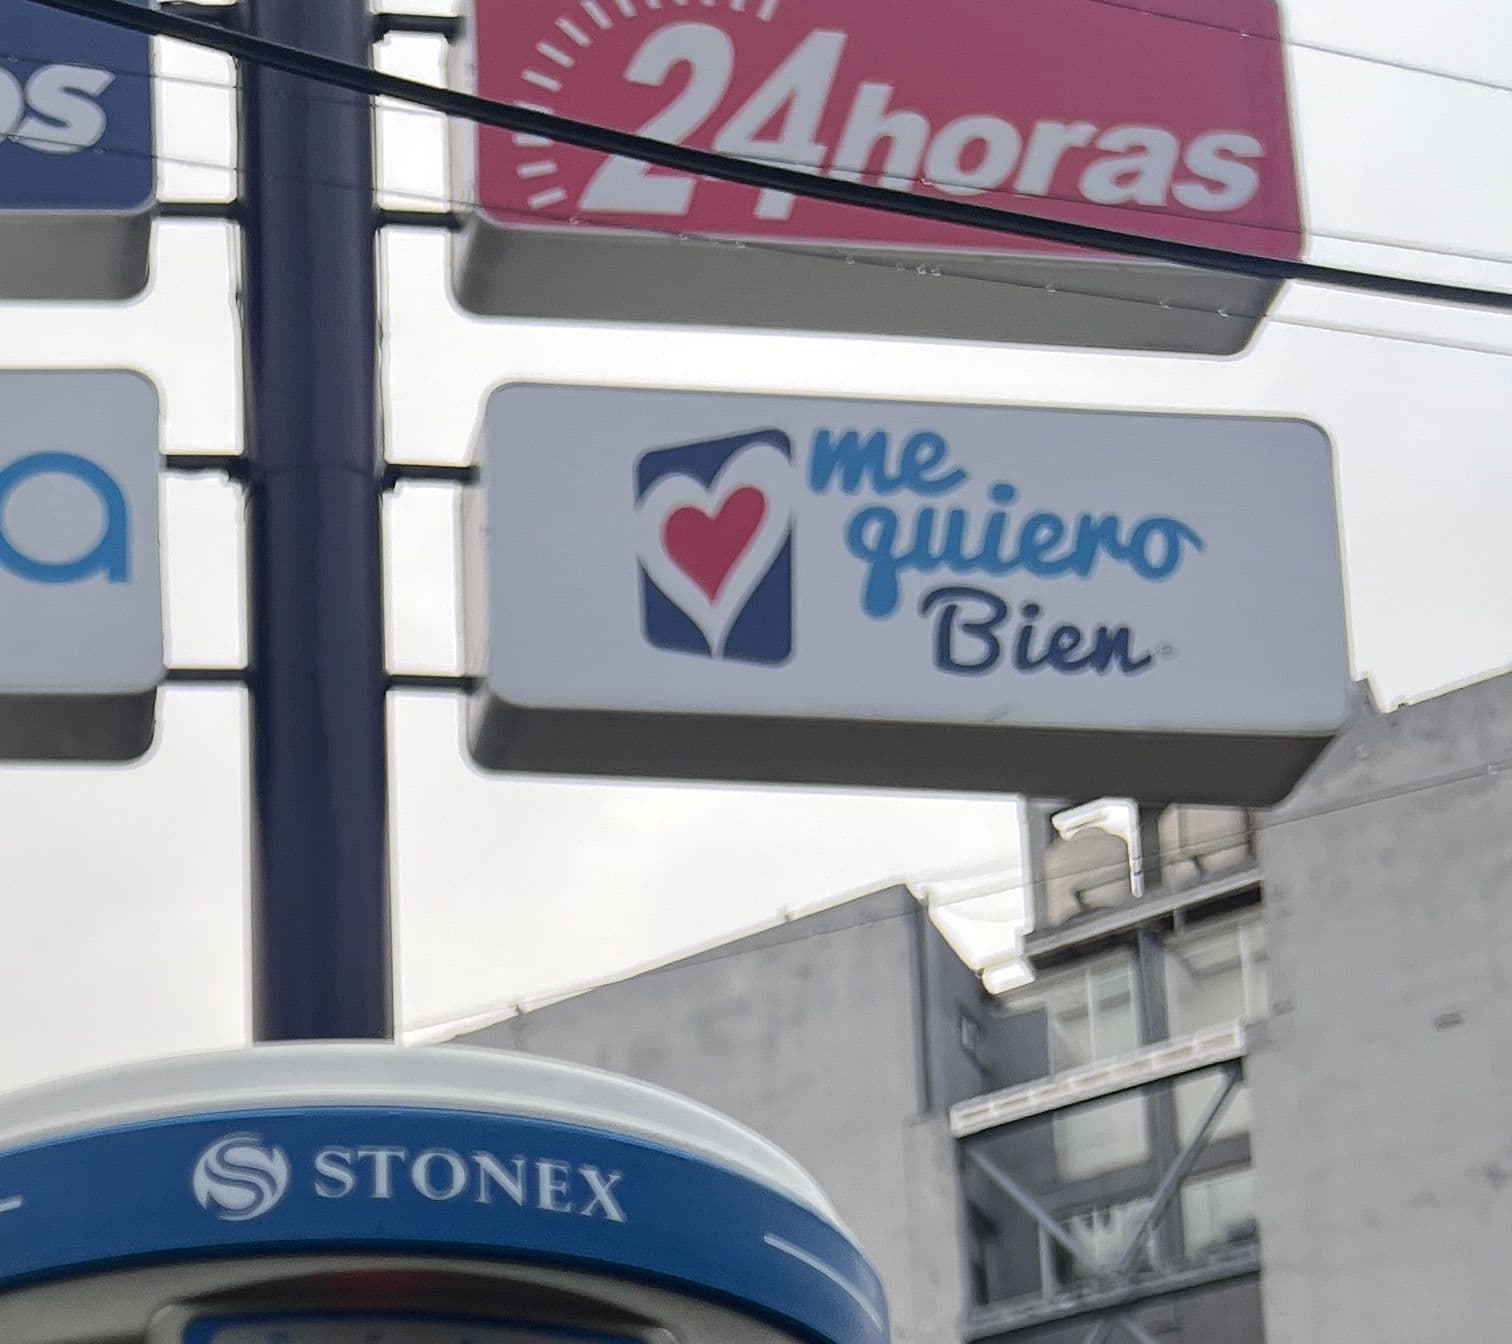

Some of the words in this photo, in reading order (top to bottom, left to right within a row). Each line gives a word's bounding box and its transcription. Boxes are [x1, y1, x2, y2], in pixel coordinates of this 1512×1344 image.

[809, 428, 968, 495] me
[845, 481, 1206, 620] quiero
[918, 585, 1154, 676] Bien
[313, 1145, 627, 1224] STONEX
